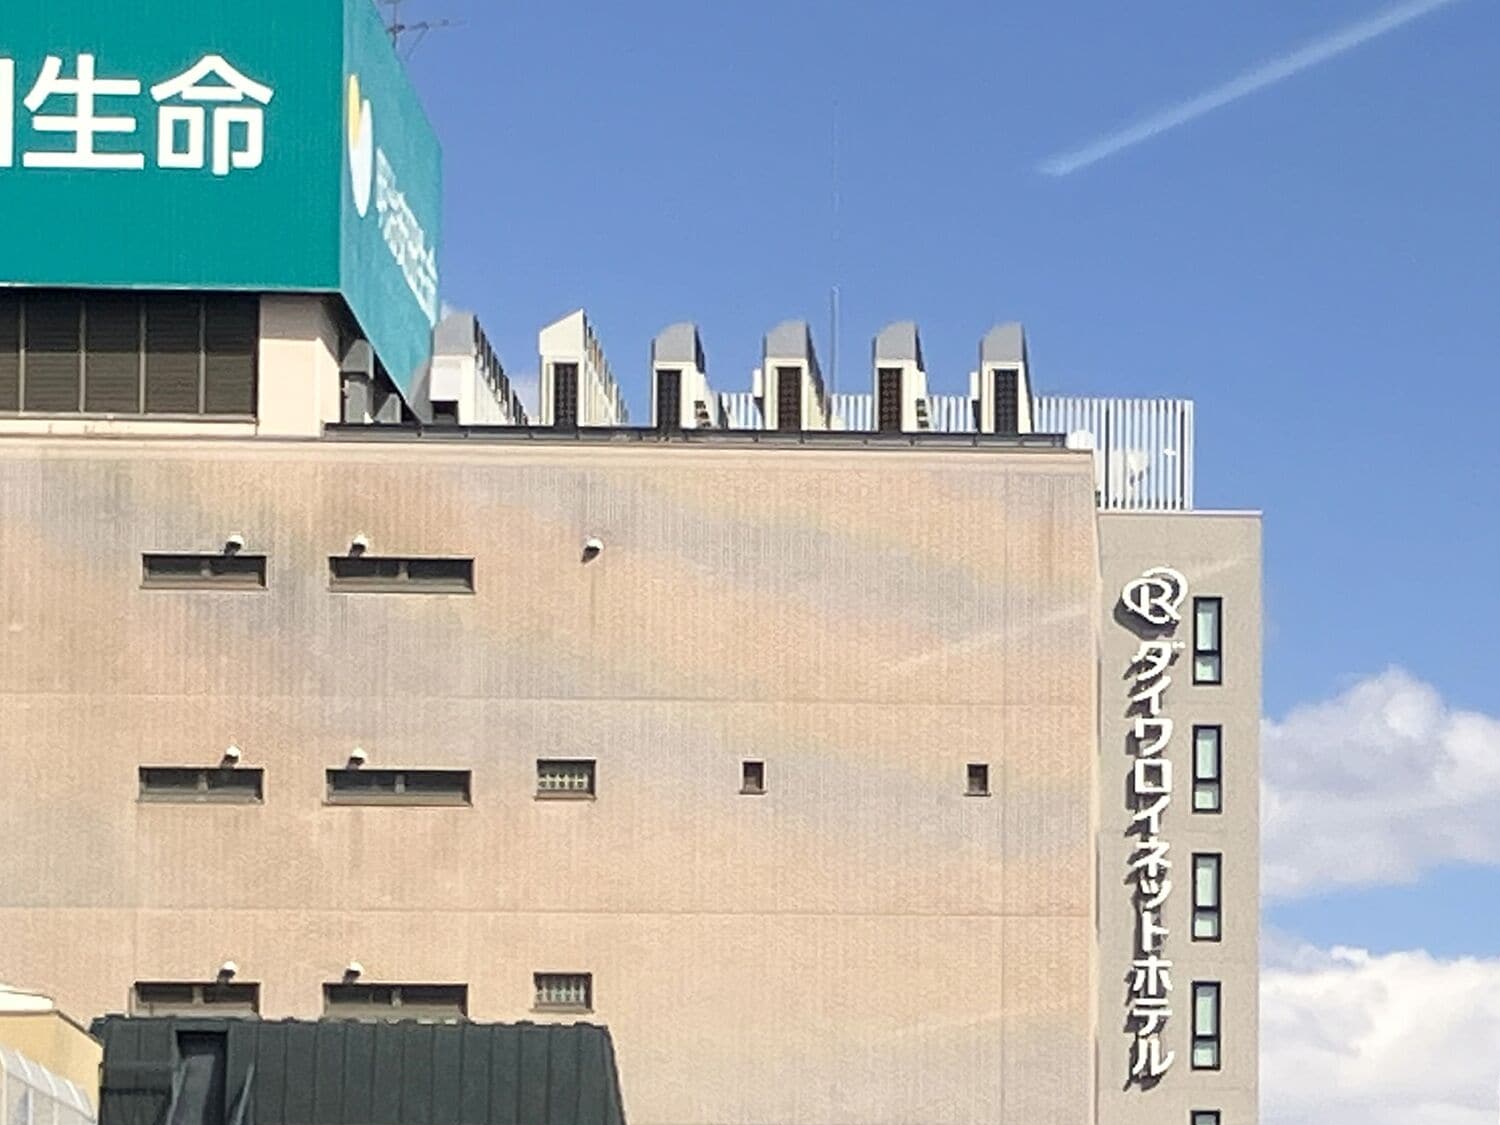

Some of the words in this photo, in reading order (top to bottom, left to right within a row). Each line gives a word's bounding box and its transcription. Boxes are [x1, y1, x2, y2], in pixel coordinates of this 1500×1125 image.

[1131, 640, 1186, 1077] ダイワロイネットホテル
